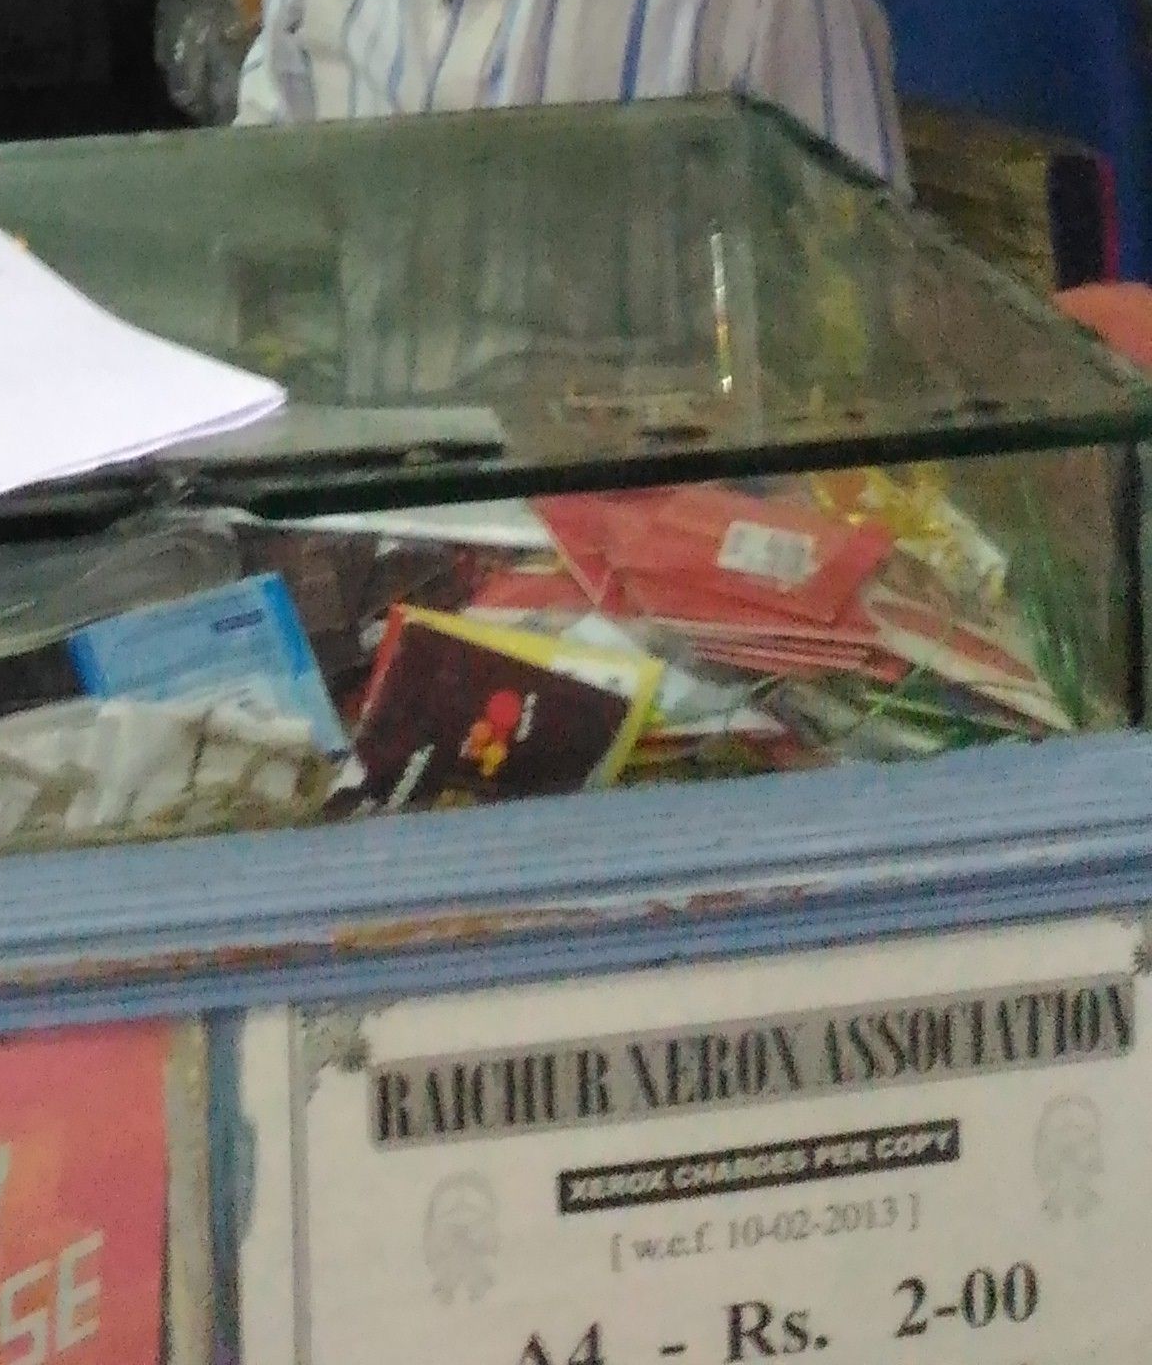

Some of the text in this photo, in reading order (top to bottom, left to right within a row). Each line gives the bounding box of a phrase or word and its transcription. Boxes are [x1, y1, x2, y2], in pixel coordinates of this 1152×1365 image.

[376, 983, 1135, 1141] RAICHUR XEROX ASSOCIATION
[568, 1129, 954, 1201] XEROX CHARGES PER COPY
[727, 1195, 901, 1250] 10-02-2013
[724, 1299, 829, 1364] Rs.
[892, 1260, 1041, 1339] 2-00
